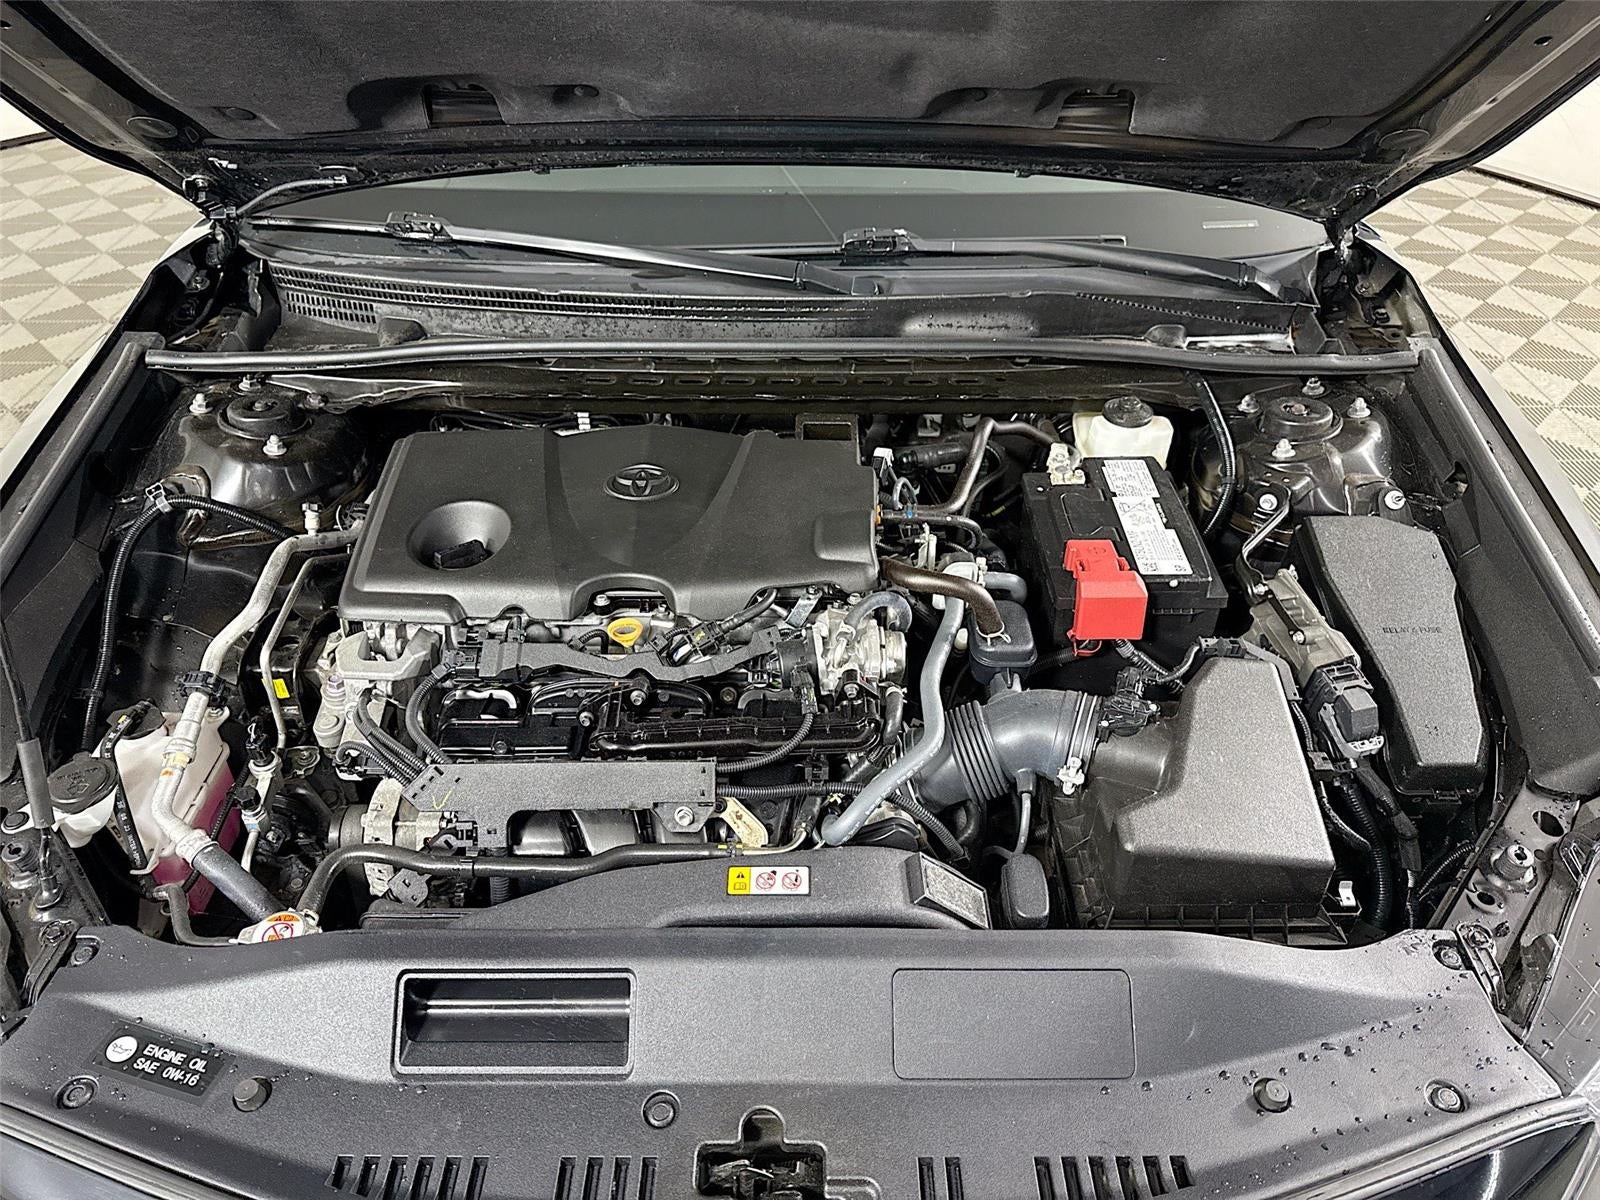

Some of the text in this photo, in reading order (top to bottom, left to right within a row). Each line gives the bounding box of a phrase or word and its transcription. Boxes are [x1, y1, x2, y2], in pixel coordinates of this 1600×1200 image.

[1382, 626, 1409, 634] RELAY
[1418, 626, 1442, 634] FUSE
[143, 1043, 207, 1072] ENGINE OIL
[133, 1058, 199, 1085] SAE 0W-16
